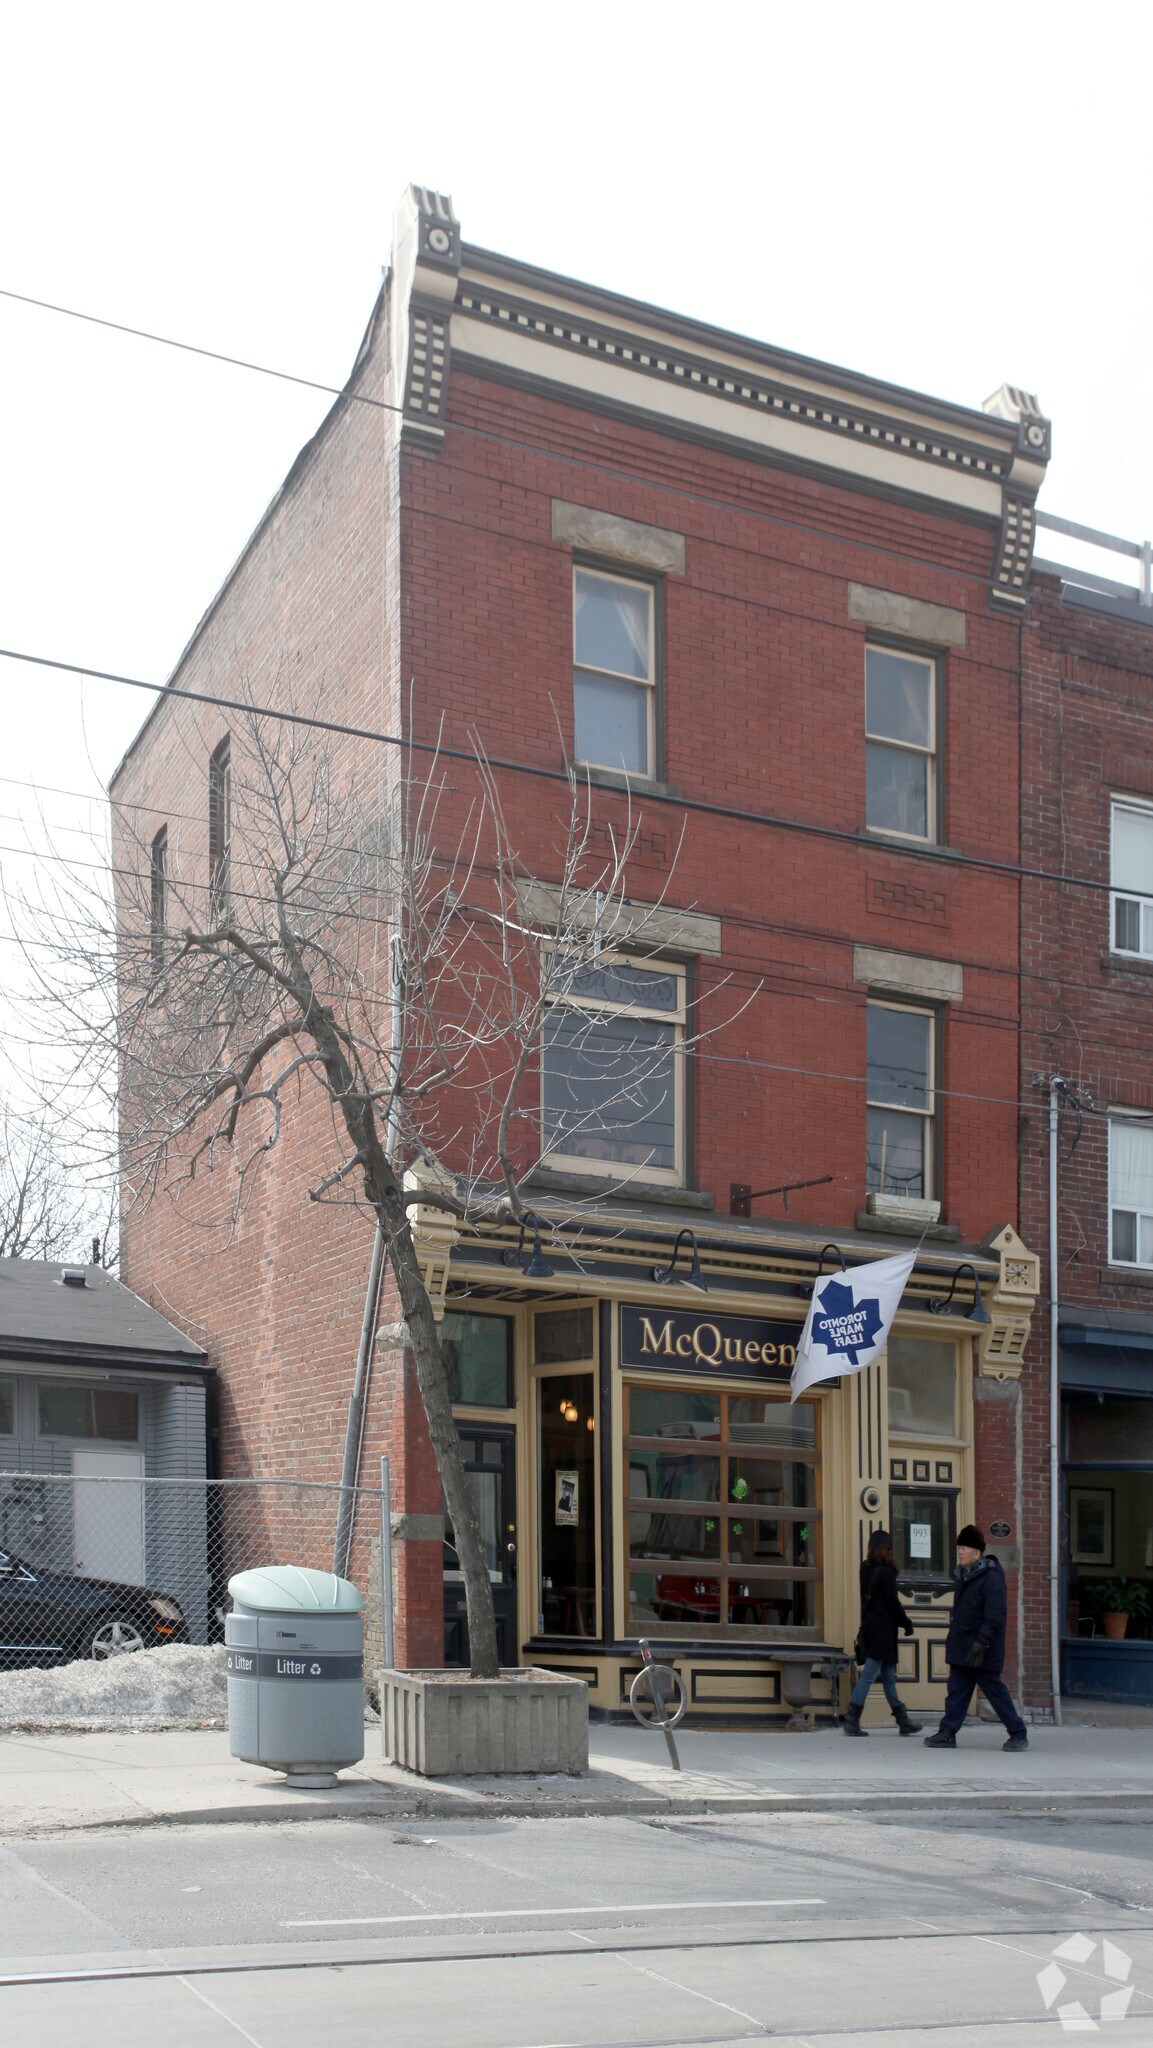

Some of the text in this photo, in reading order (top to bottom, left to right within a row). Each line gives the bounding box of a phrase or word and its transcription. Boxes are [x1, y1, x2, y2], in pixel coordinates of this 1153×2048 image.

[913, 1527, 928, 1538] 993
[235, 1654, 253, 1671] Litter
[277, 1658, 306, 1675] Litter
